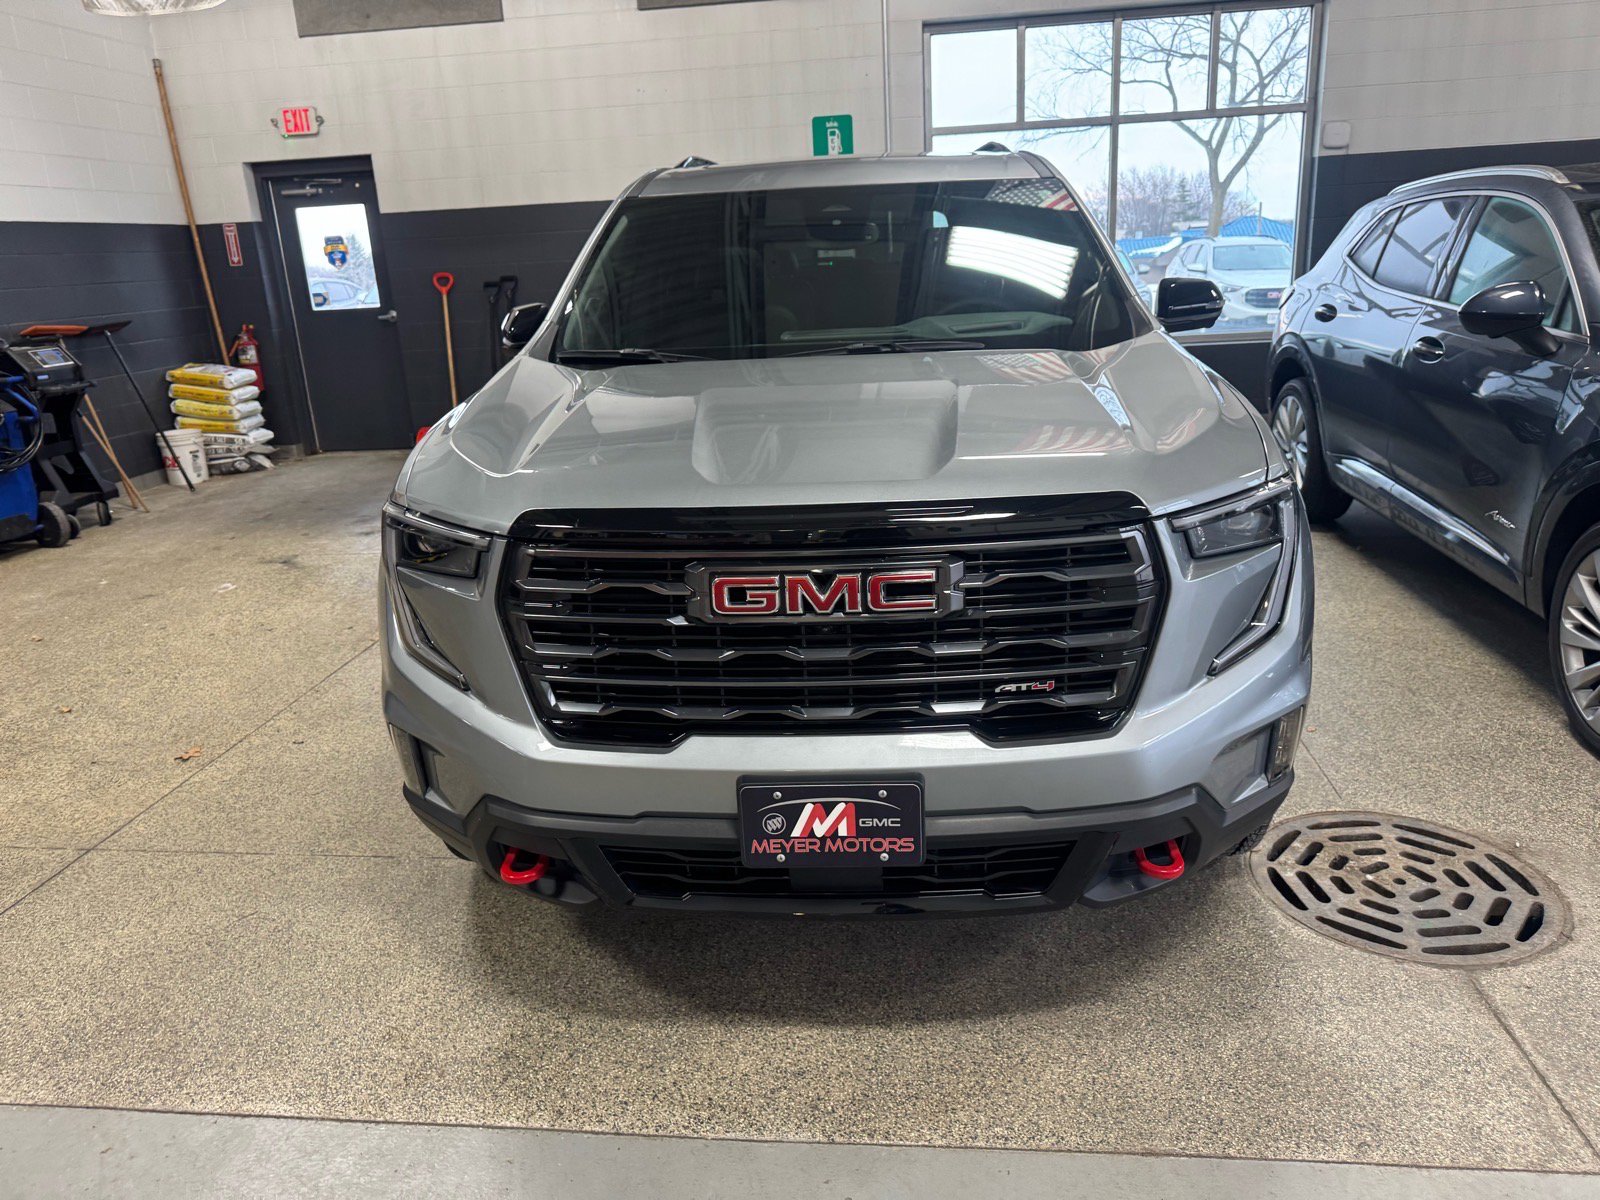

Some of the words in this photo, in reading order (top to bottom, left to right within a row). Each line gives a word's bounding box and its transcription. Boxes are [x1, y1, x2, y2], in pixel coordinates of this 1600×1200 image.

[282, 109, 311, 133] EXIT
[711, 570, 937, 615] GMC
[995, 681, 1054, 693] AT4
[859, 818, 901, 827] GMC
[751, 838, 820, 854] MEYER
[825, 837, 915, 853] MOTORS
